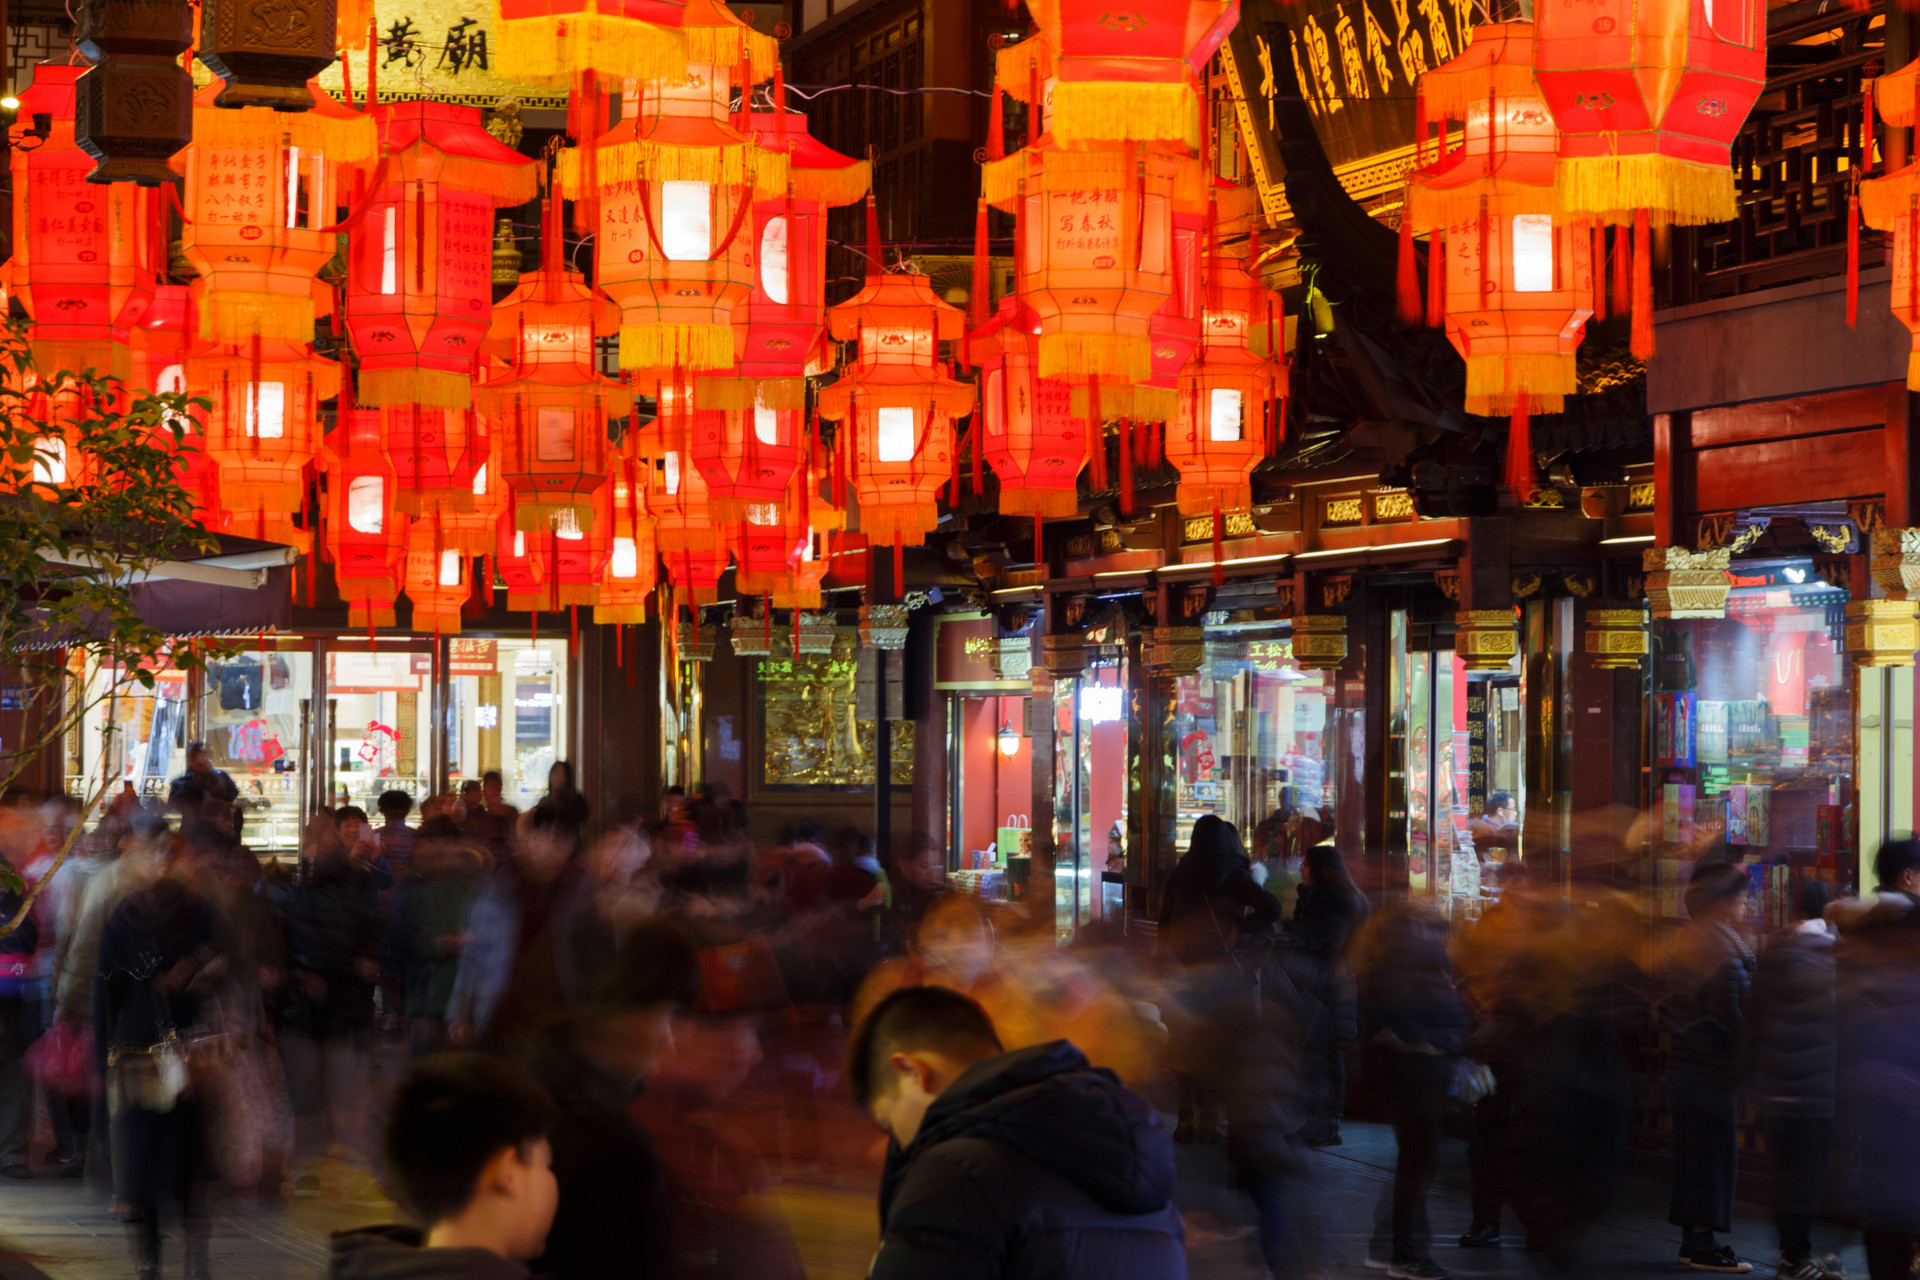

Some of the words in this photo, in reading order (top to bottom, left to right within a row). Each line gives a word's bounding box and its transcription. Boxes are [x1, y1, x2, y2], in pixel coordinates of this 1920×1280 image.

[1595, 18, 1613, 33] 19
[1060, 212, 1115, 233] 写春秋
[630, 250, 642, 262] 65
